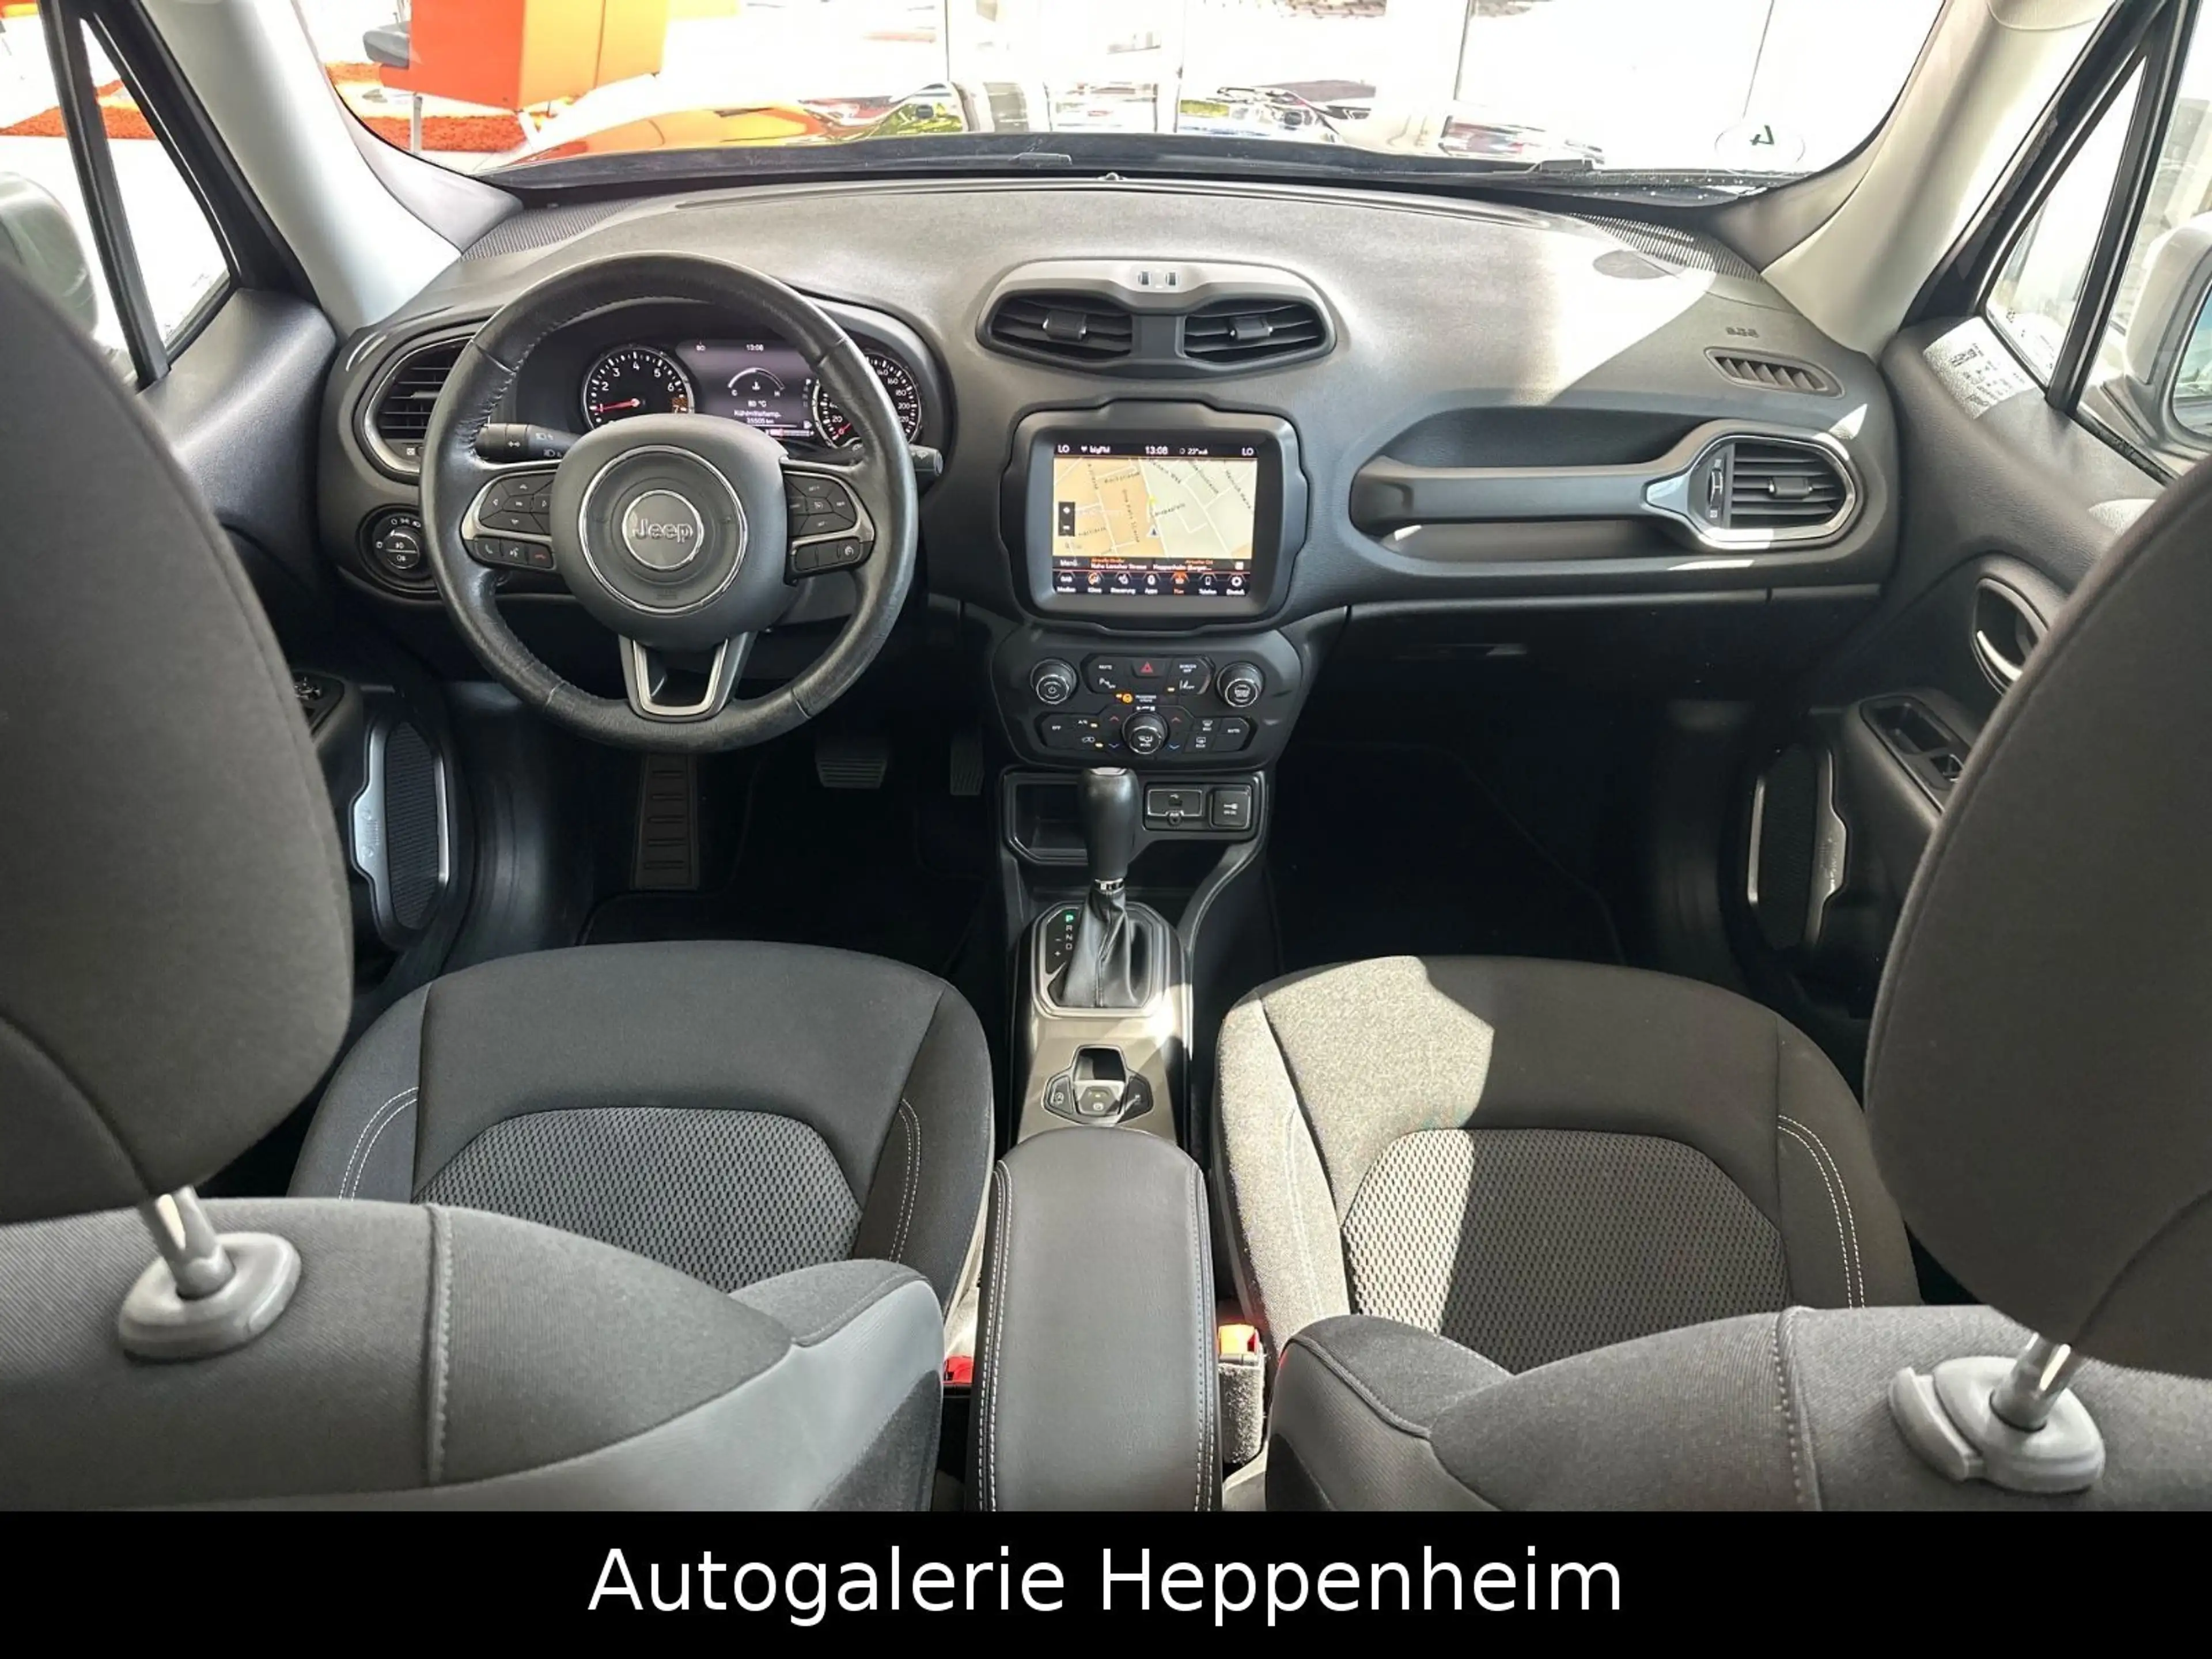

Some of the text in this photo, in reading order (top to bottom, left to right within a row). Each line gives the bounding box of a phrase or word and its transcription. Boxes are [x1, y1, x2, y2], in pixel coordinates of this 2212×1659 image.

[632, 361, 640, 370] 4
[612, 368, 620, 377] 3
[654, 368, 661, 378] 5
[601, 381, 609, 391] 2
[667, 382, 674, 392] 6
[1058, 445, 1070, 453] LO
[1145, 446, 1168, 454] 13:08
[1241, 447, 1254, 456] LO
[632, 518, 693, 543] Jeep
